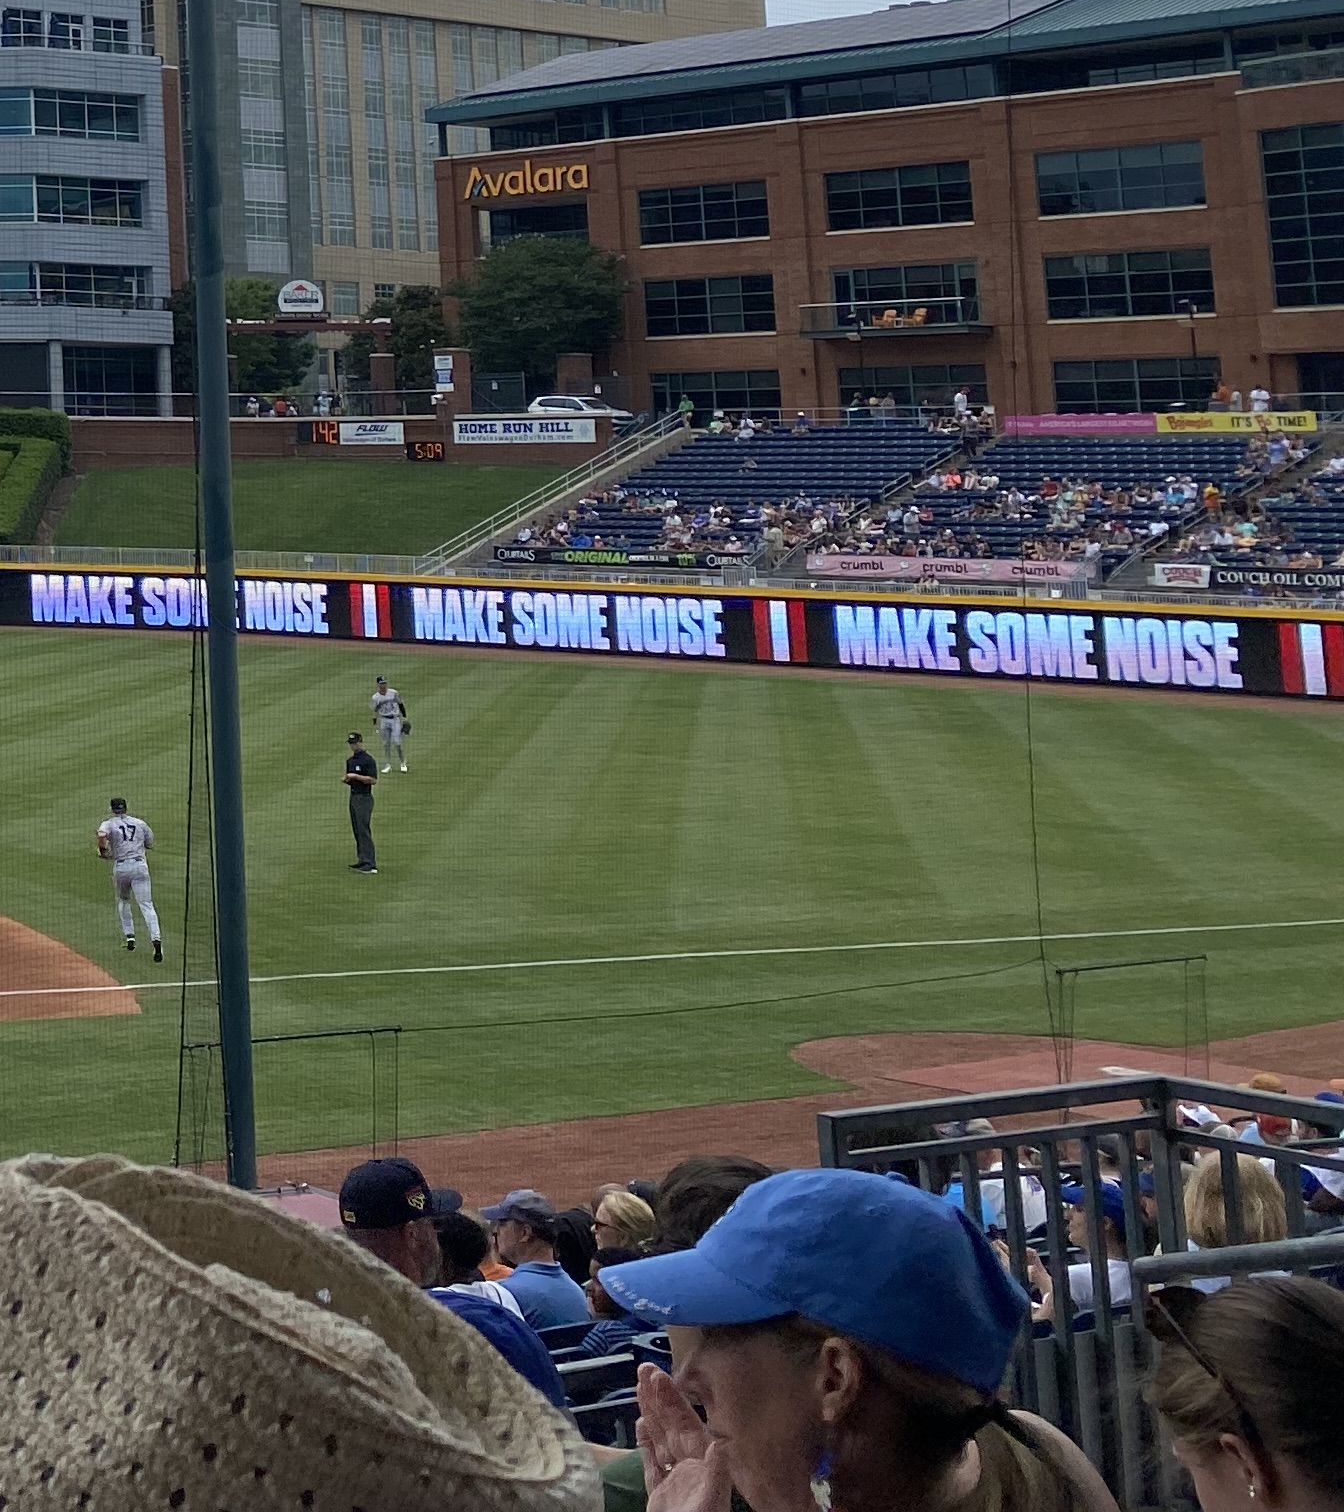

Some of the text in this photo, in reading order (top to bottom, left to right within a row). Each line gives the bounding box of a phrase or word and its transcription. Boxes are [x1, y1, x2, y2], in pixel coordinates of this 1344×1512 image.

[464, 160, 589, 199] Avalara
[459, 422, 573, 433] HOME RUN HILL
[1231, 416, 1253, 427] IT'S
[1277, 416, 1307, 427] TIME!
[356, 424, 388, 432] FLOW
[564, 551, 629, 563] ORIGINAL
[840, 560, 885, 571] crumbl
[922, 563, 969, 574] crumbl
[1012, 565, 1061, 576] crumbl
[1217, 571, 1344, 586] COUCH OIL COM
[29, 574, 329, 634] MAKE SOM NOISE
[411, 587, 726, 657] MAKE SOME NOISE
[834, 605, 1243, 688] MAKE SOME NOISE
[118, 824, 137, 842] 17
